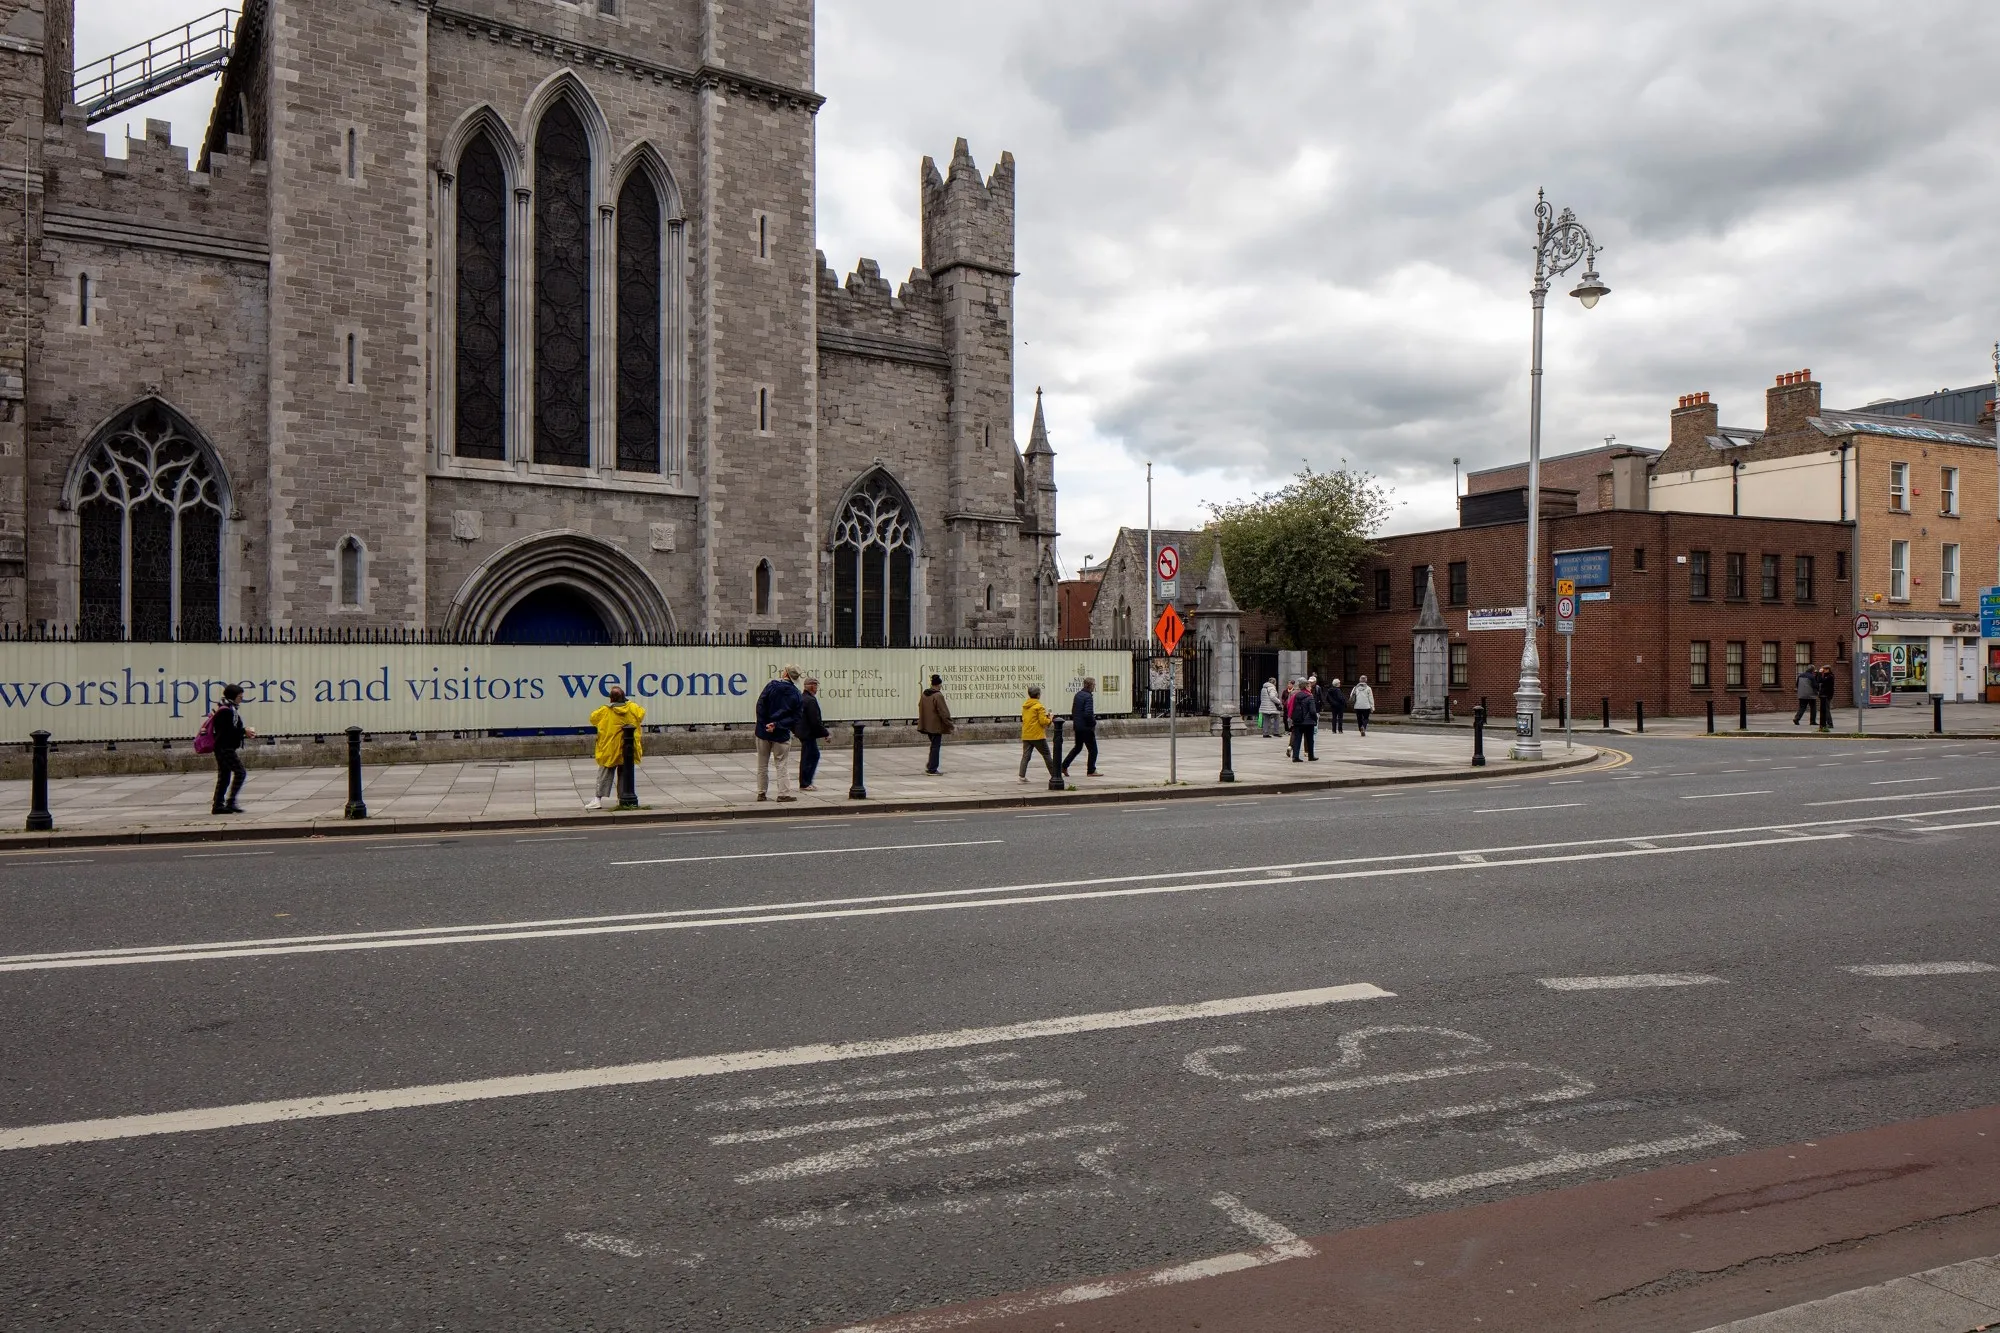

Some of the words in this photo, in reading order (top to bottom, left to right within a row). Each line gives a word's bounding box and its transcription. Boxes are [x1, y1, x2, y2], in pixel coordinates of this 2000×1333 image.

[1562, 602, 1570, 611] 30
[928, 665, 941, 673] WE
[942, 665, 957, 673] ARE
[959, 665, 999, 673] RESTORING
[1001, 665, 1016, 673] OUR
[767, 664, 820, 679] Prect
[824, 668, 849, 679] our
[852, 668, 883, 684] past,
[950, 674, 969, 682] VISIT
[970, 674, 985, 682] CAN
[986, 674, 1005, 682] HELP
[1007, 674, 1016, 682] TO
[1018, 674, 1045, 682] ENSURE
[0, 667, 297, 718] worshippers
[314, 666, 391, 702] and
[405, 667, 544, 701] visitors
[558, 661, 747, 699] welcome
[828, 688, 852, 699] our
[857, 683, 900, 699] future.
[968, 683, 1010, 691] CATHEDRAL
